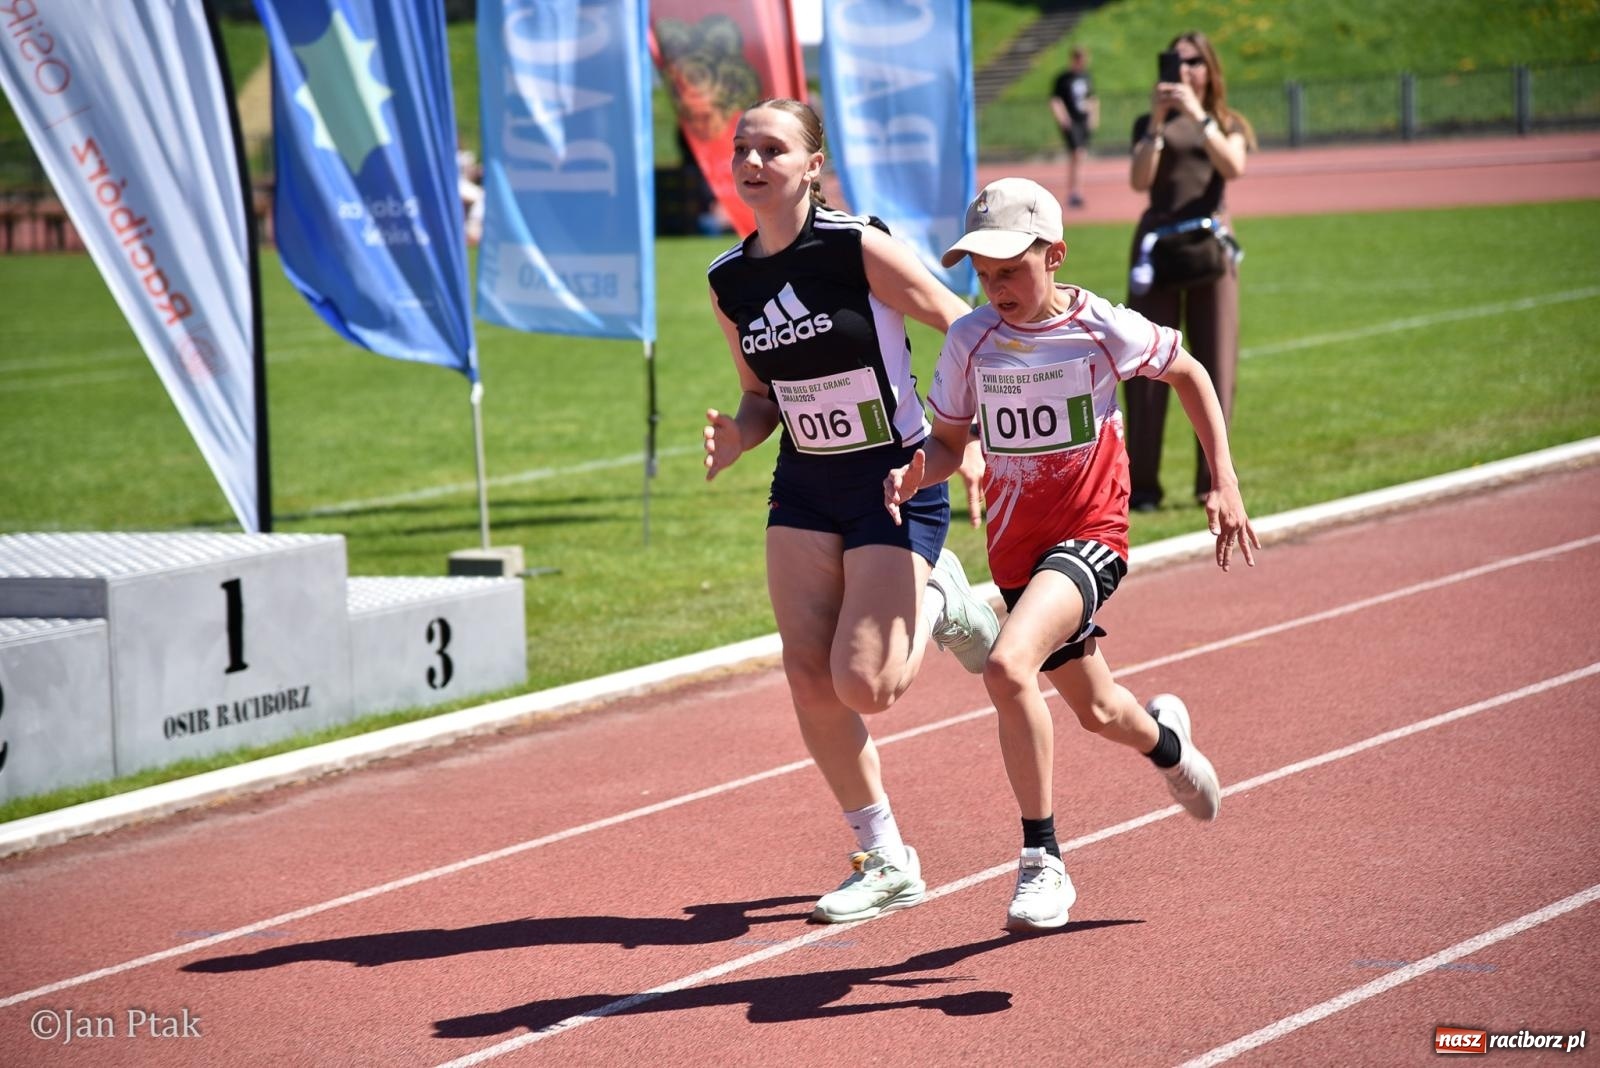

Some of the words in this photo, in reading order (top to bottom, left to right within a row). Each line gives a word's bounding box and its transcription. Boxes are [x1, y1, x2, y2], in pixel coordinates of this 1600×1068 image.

[742, 313, 833, 354] adidas
[793, 385, 808, 394] BIEG
[808, 383, 822, 393] BEZ
[823, 377, 851, 391] GRANIC
[982, 374, 997, 384] XVIII
[998, 374, 1015, 384] BIEG
[1016, 374, 1031, 384] BEZ
[1033, 368, 1064, 383] GRANIC
[798, 409, 852, 441] 016
[996, 405, 1057, 439] 010
[220, 578, 250, 675] 1
[425, 617, 454, 690] 3
[163, 707, 211, 740] OSIR
